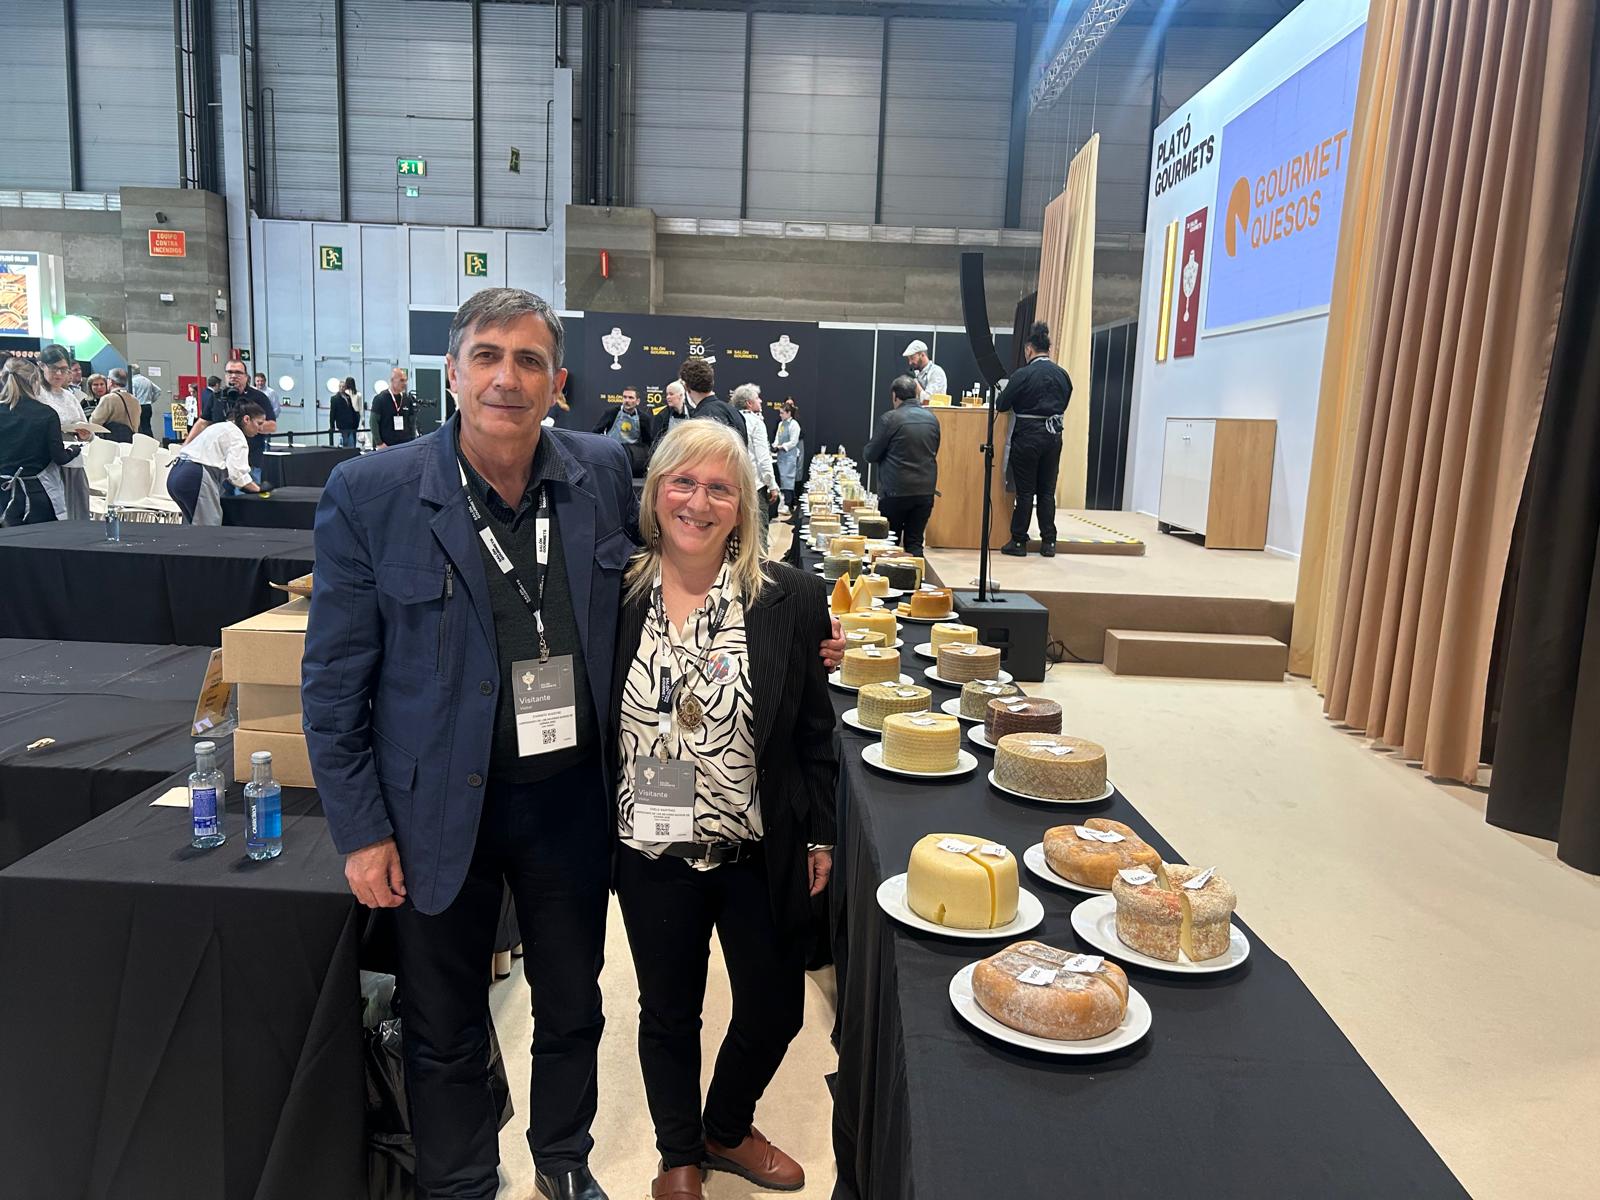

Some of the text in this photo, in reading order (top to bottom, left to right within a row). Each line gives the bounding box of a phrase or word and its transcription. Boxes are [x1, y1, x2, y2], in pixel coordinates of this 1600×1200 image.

[1156, 113, 1191, 170] PLATÓ
[1155, 134, 1214, 197] GOURMETS
[1254, 128, 1348, 209] GOURMET
[1251, 189, 1321, 249] QUESOS
[156, 232, 178, 240] EQUIPO
[689, 345, 705, 355] 50
[647, 394, 662, 404] 50
[519, 694, 551, 705] Visitante
[638, 789, 668, 798] Visitante
